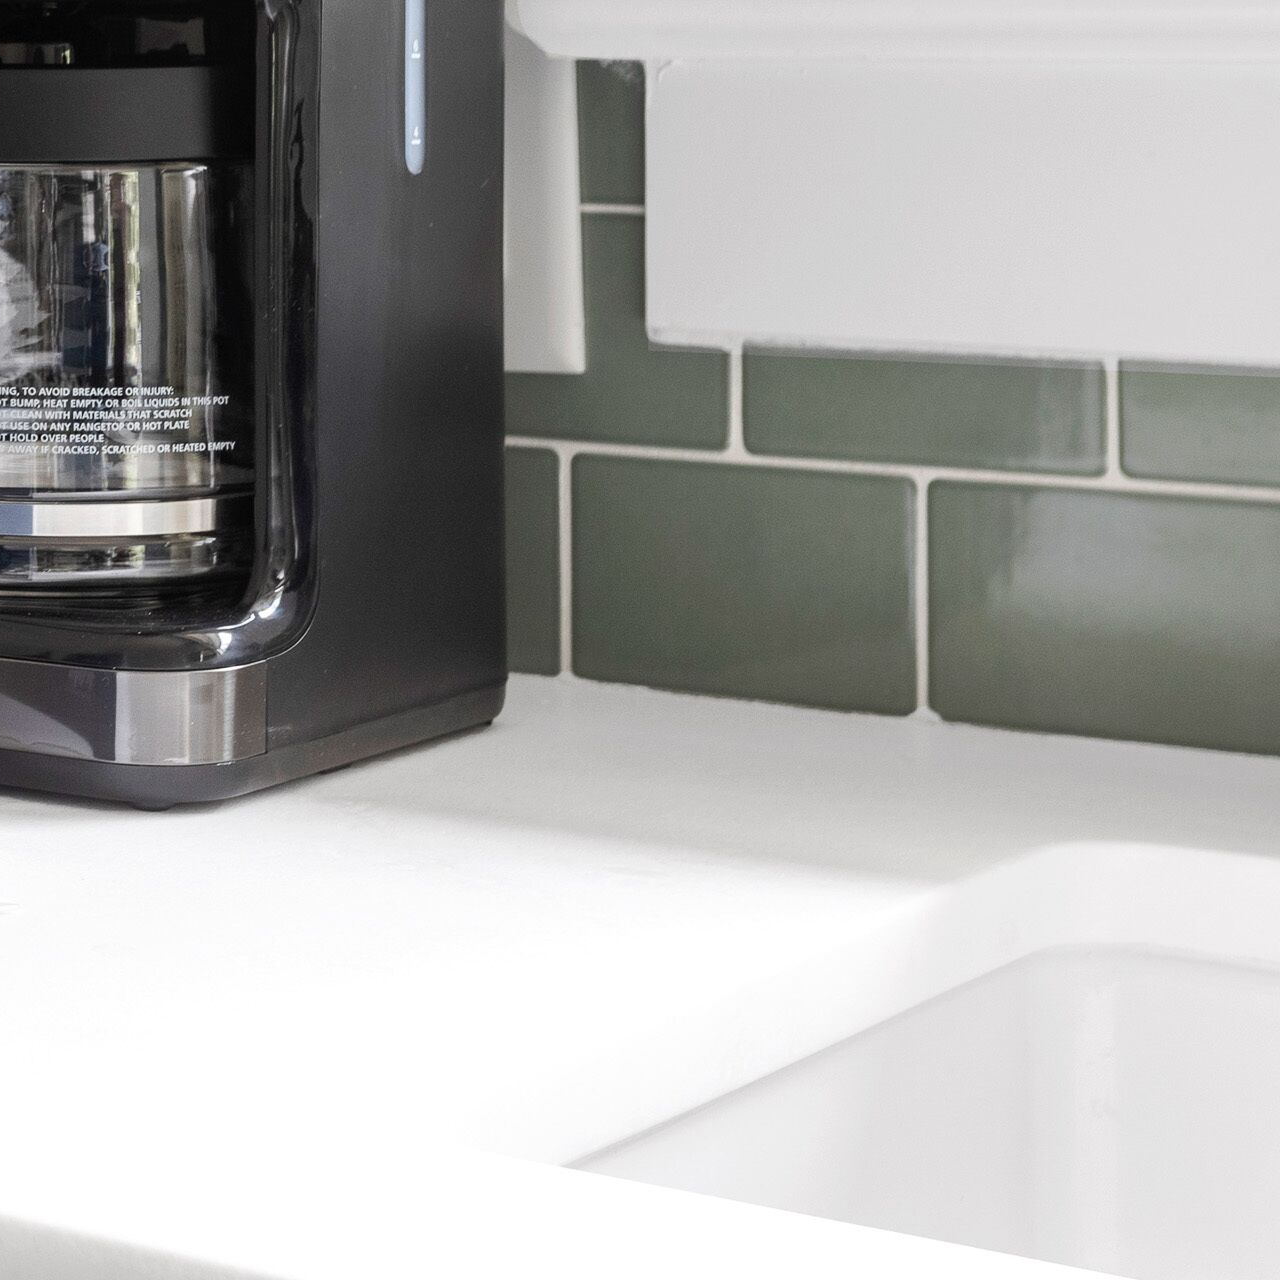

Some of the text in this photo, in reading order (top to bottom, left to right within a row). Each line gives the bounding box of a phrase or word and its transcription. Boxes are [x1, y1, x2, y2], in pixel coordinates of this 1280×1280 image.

[22, 387, 36, 396] TO
[39, 387, 70, 396] AVOID
[72, 387, 123, 396] BREAKAGE
[125, 387, 139, 396] OR
[10, 398, 40, 409] BUMP,
[43, 399, 69, 408] HEAT
[70, 399, 103, 408] EMPTY
[105, 399, 119, 408] OR
[122, 398, 142, 408] BOIL
[144, 398, 179, 408] LIQUIDS
[181, 397, 190, 406] IN
[192, 396, 211, 406] THIS
[213, 396, 229, 405] POT
[10, 410, 41, 419] CLEAN
[44, 410, 70, 419] WITH
[72, 410, 125, 420] MATERIALS
[127, 410, 150, 419] THAT
[153, 409, 192, 419] SCRATCH
[10, 422, 30, 430] USE
[31, 422, 47, 431] ON
[49, 422, 71, 431] ANY
[73, 422, 125, 431] RANGETOP
[127, 422, 140, 431] OR
[142, 421, 162, 430] HOT
[163, 420, 190, 430] PLATE
[10, 433, 38, 442] HOLD
[40, 434, 68, 442] OVER
[69, 434, 104, 443] PEOPLE
[7, 445, 39, 454] AWAY
[41, 446, 50, 454] IF
[51, 446, 100, 455] CRACKED,
[101, 445, 155, 454] SCRATCHED
[157, 444, 171, 453] OR
[172, 442, 206, 453] HEATED
[208, 441, 236, 451] EMPTY
